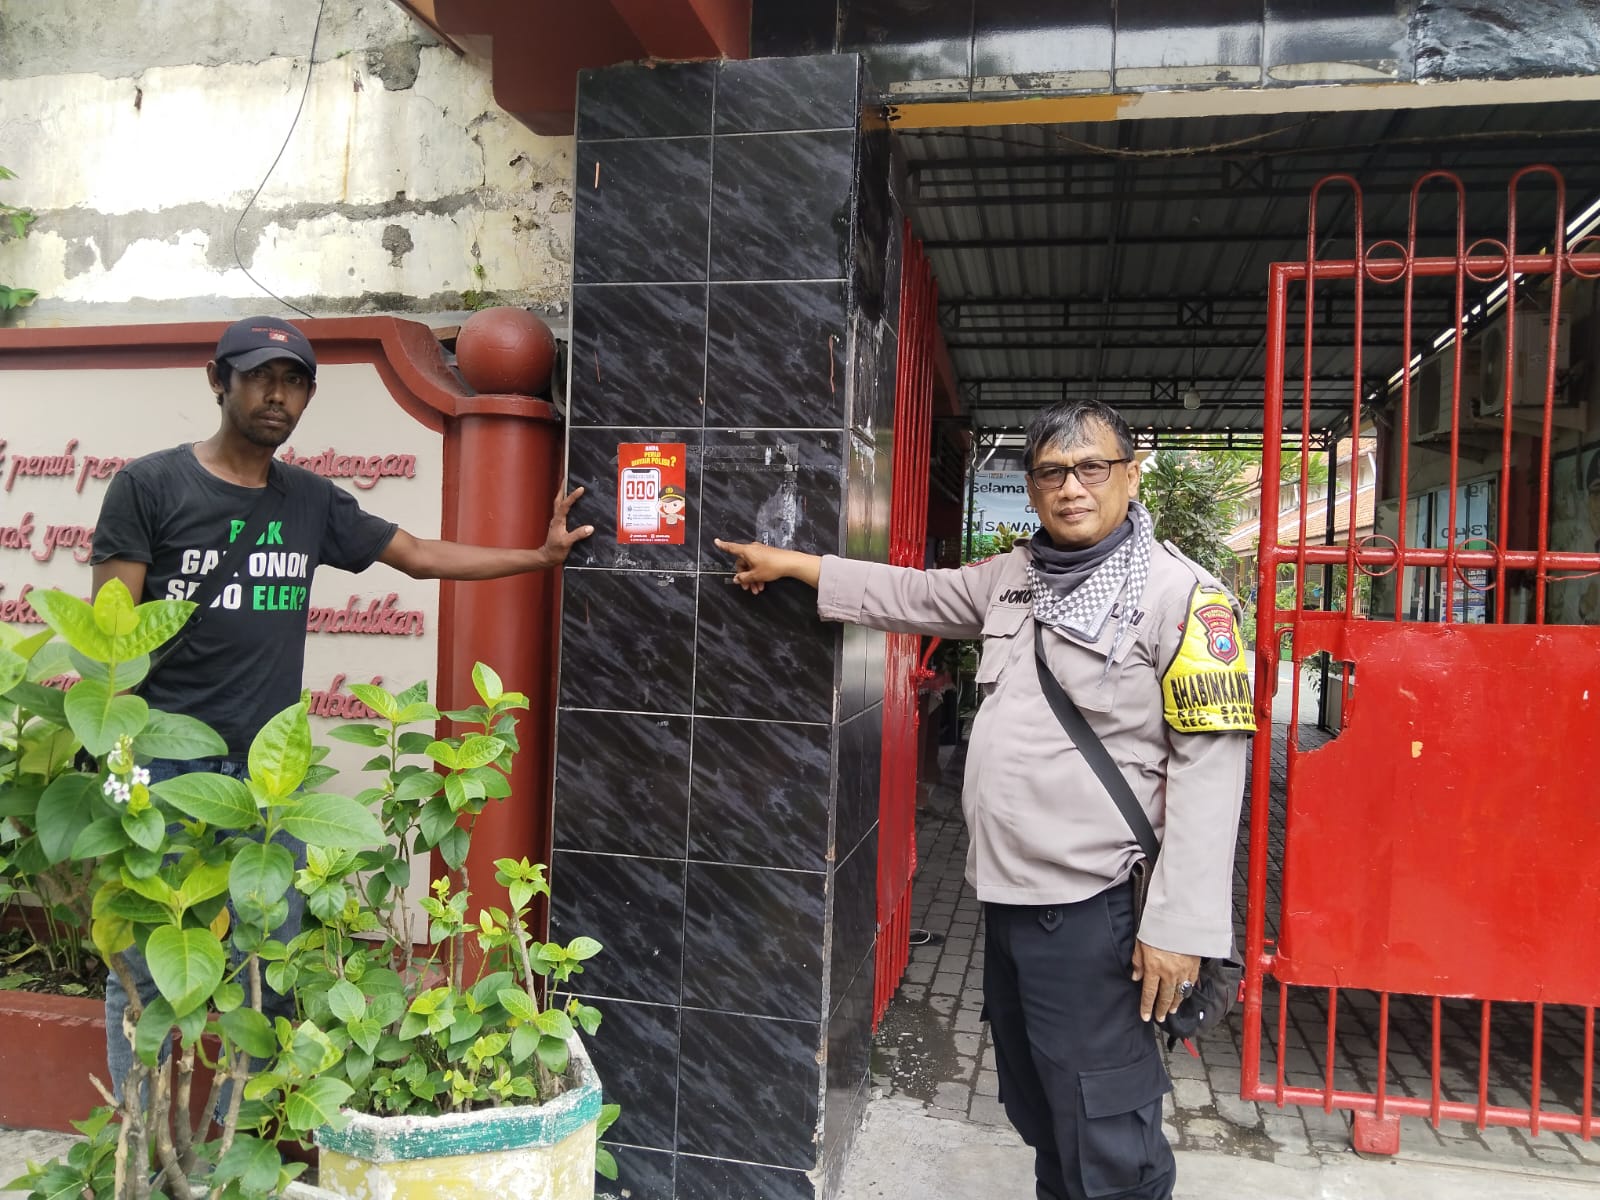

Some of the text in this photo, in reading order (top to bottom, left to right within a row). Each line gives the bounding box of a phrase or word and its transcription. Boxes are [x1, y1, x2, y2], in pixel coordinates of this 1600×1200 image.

[5, 438, 79, 493] penuh
[626, 482, 655, 498] 110
[229, 519, 283, 545] PK
[249, 552, 308, 578] ONOK
[252, 585, 306, 611] ELEK?
[1000, 589, 1033, 604] JOKO
[306, 592, 424, 638] endidikan
[1180, 717, 1213, 728] KEC.
